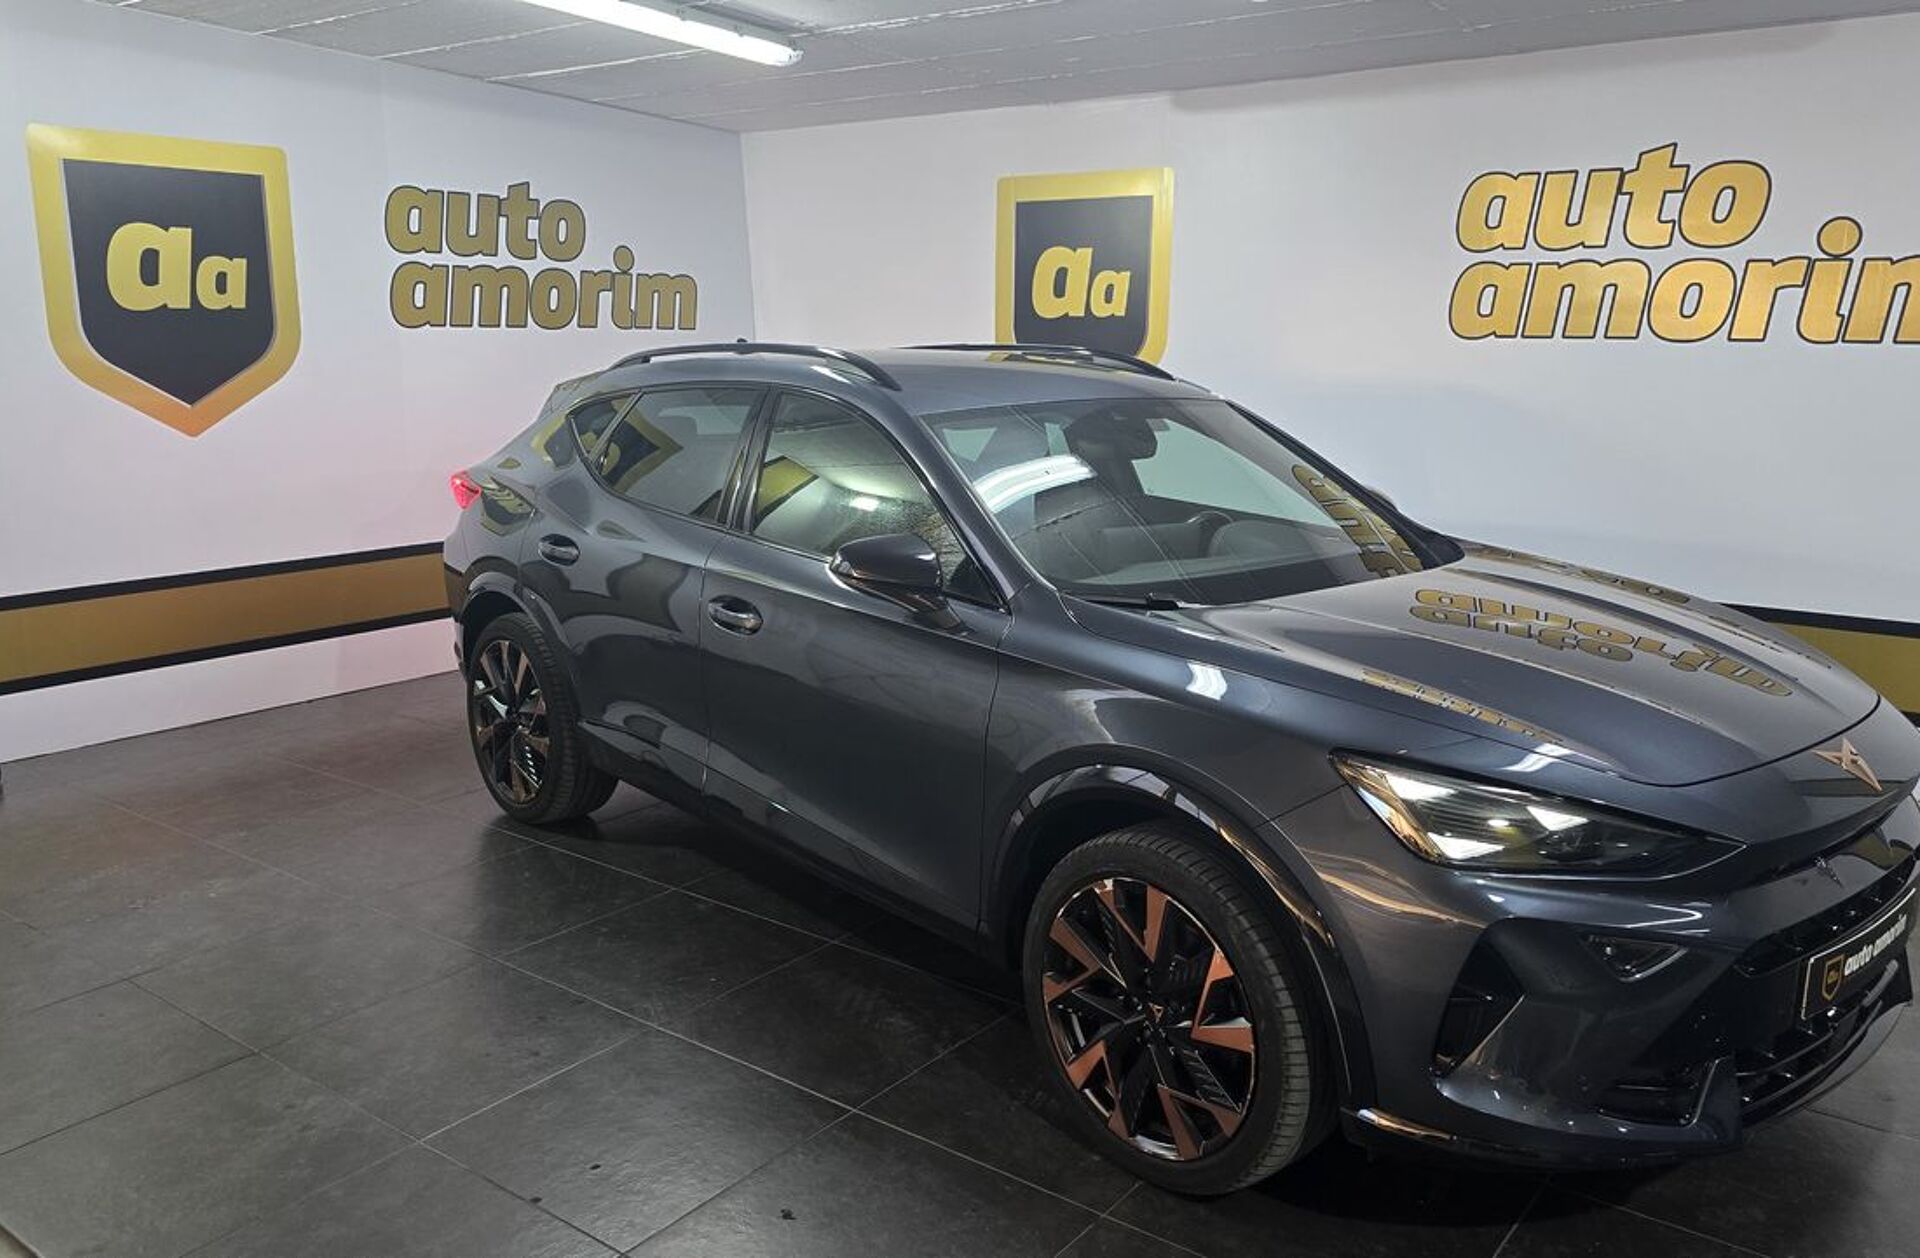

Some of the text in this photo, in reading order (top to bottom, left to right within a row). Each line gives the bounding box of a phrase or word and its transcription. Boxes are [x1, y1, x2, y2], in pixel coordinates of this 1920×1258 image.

[384, 181, 587, 262] auto
[1456, 142, 1773, 253] auto
[388, 245, 698, 331] amorim
